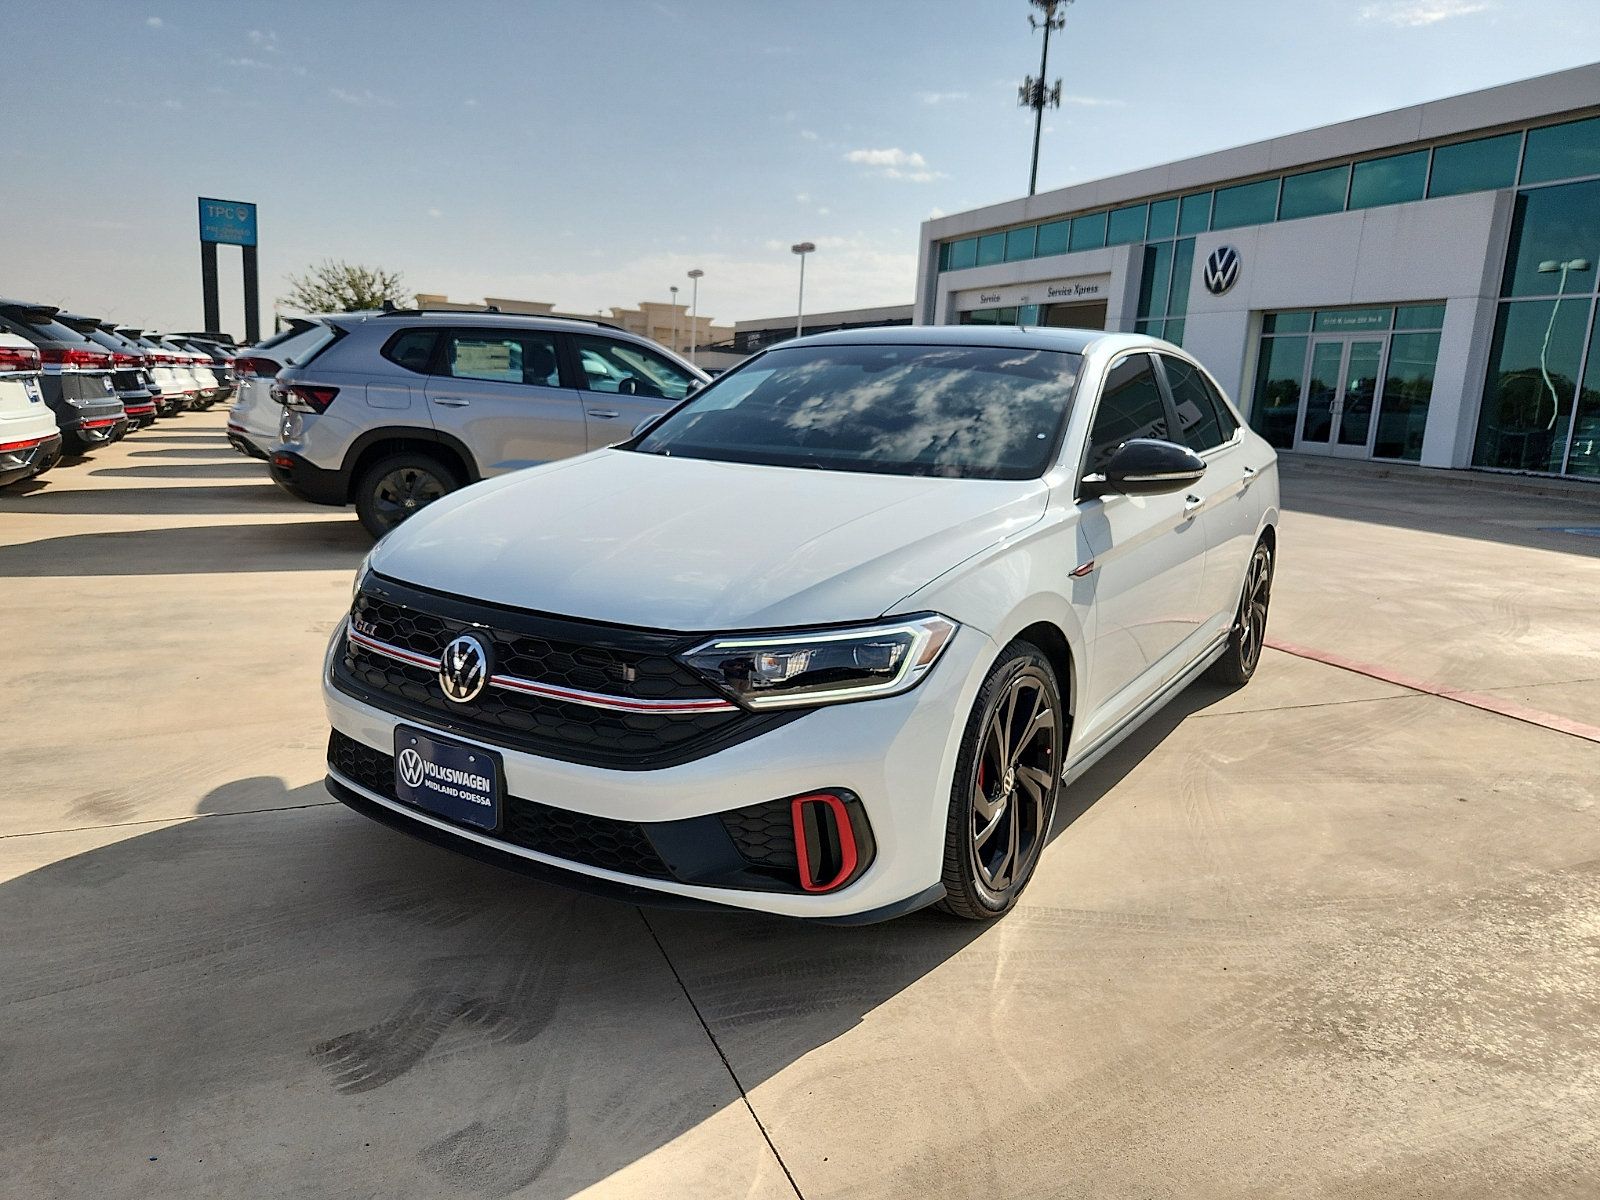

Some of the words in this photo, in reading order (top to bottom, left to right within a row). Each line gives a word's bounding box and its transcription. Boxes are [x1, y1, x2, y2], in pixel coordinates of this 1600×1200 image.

[980, 293, 1001, 304] Service
[1047, 286, 1072, 298] Service
[1073, 283, 1099, 295] Xpress
[423, 759, 490, 793] VOLKSWAGEN
[425, 778, 458, 797] MIDLAND
[459, 790, 491, 807] ODESSA
